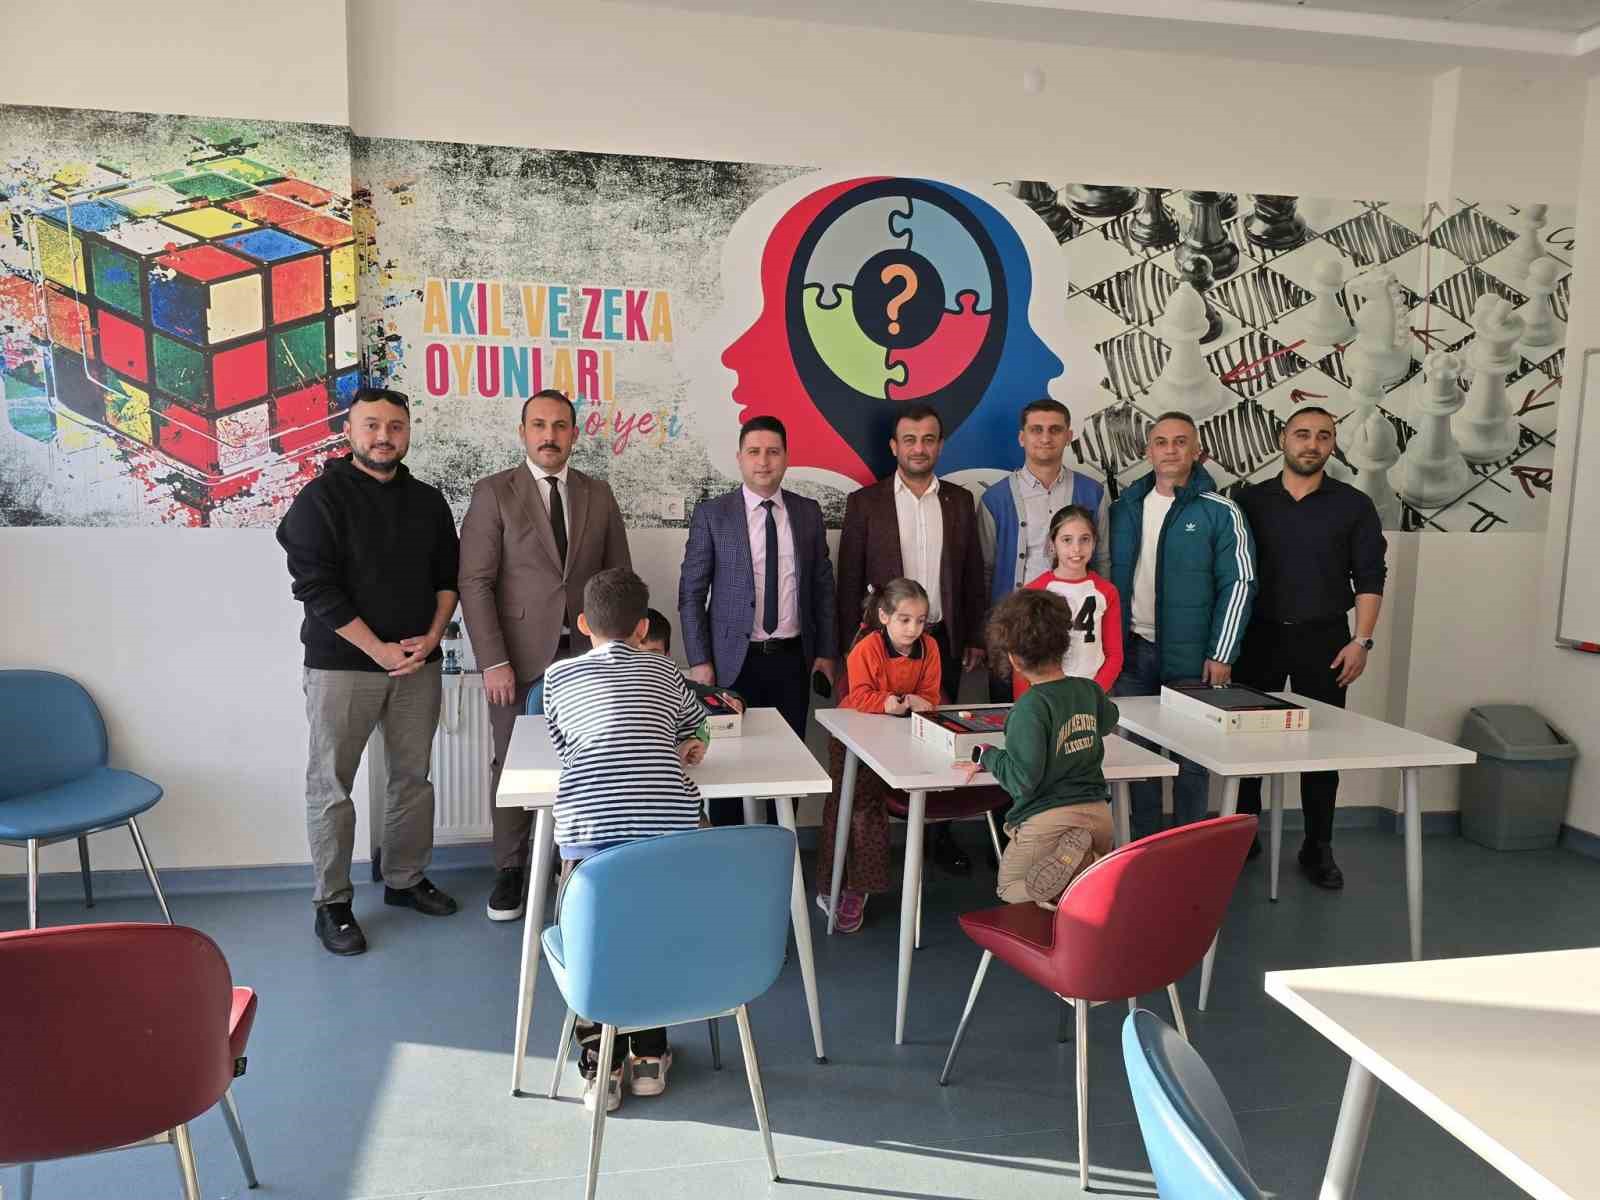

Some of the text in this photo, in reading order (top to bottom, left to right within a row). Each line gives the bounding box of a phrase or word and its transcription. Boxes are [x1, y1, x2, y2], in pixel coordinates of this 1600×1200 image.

[424, 279, 673, 342] AKIL VE ZEKA
[1073, 596, 1096, 642] 4
